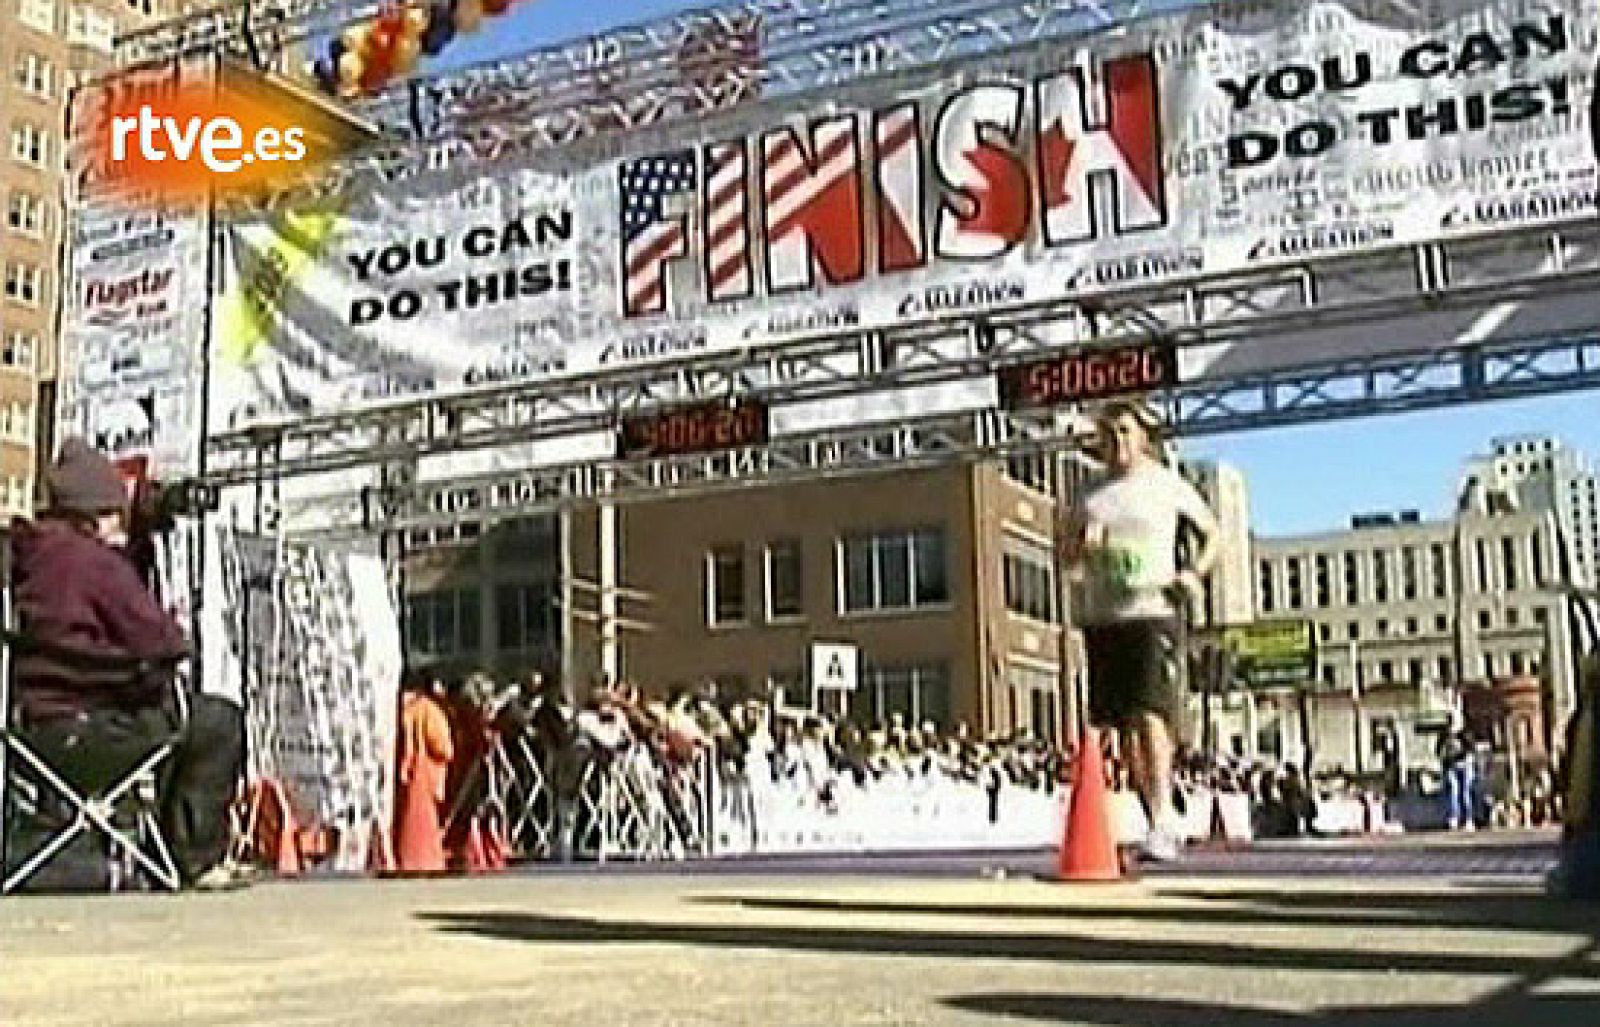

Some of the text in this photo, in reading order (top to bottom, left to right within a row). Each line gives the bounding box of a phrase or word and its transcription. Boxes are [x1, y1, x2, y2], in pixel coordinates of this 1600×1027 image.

[1217, 14, 1567, 111] YOU CAN
[1227, 120, 1336, 169] DO
[1357, 74, 1571, 146] THIS!
[618, 51, 1168, 318] FINISH
[347, 234, 446, 282] YOU
[461, 209, 574, 258] CAN
[349, 259, 574, 327] DO THIS!
